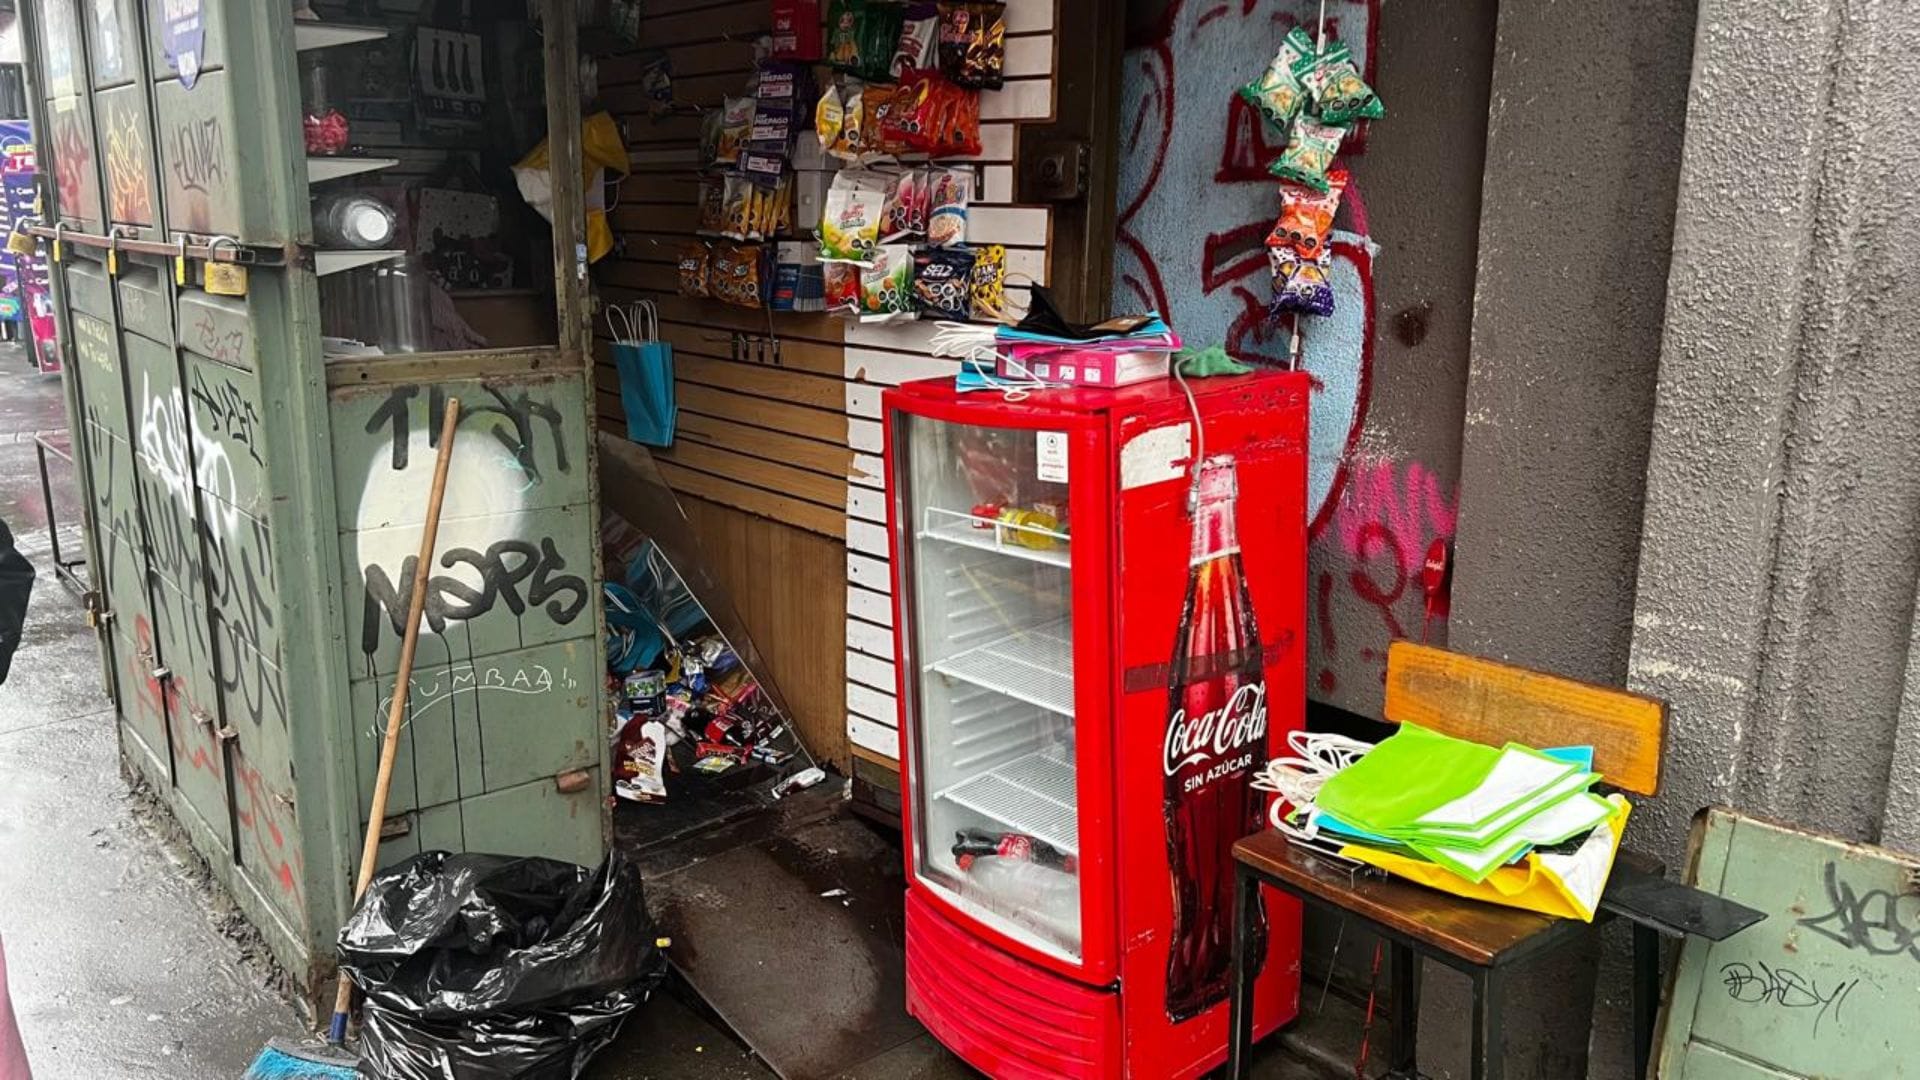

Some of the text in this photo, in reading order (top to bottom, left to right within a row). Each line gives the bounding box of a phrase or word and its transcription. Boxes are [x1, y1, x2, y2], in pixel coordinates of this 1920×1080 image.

[760, 73, 792, 81] PREPAGO
[922, 263, 954, 277] SELZ
[1164, 681, 1266, 776] Coca-Cola
[1184, 753, 1253, 793] SIN AZÚCAR
